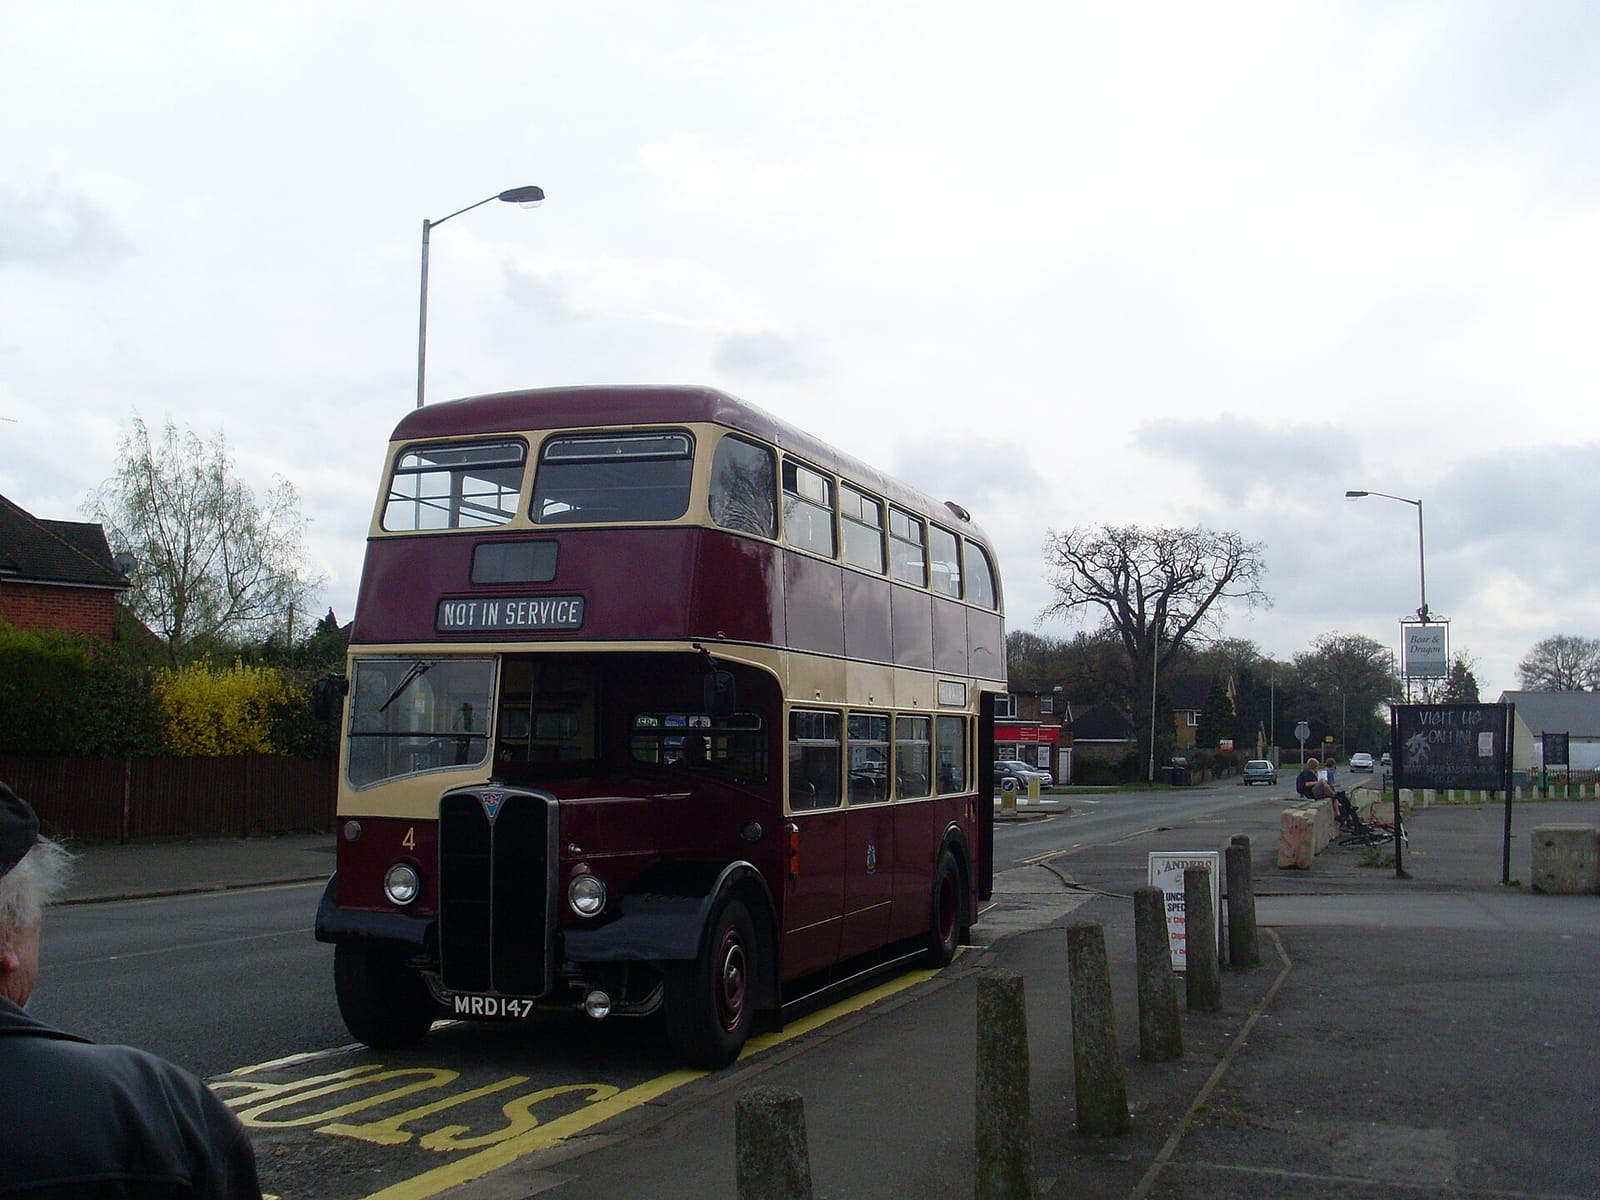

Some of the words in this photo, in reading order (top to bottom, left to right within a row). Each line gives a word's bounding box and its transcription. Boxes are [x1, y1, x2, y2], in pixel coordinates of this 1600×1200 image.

[444, 603, 477, 626] NOT
[481, 602, 499, 626] IN
[505, 601, 580, 625] SERVICE
[1410, 635, 1430, 644] Bear
[1431, 635, 1440, 644] &
[1410, 645, 1441, 656] Dragon
[1419, 711, 1454, 726] VISIT
[401, 826, 416, 851] 4
